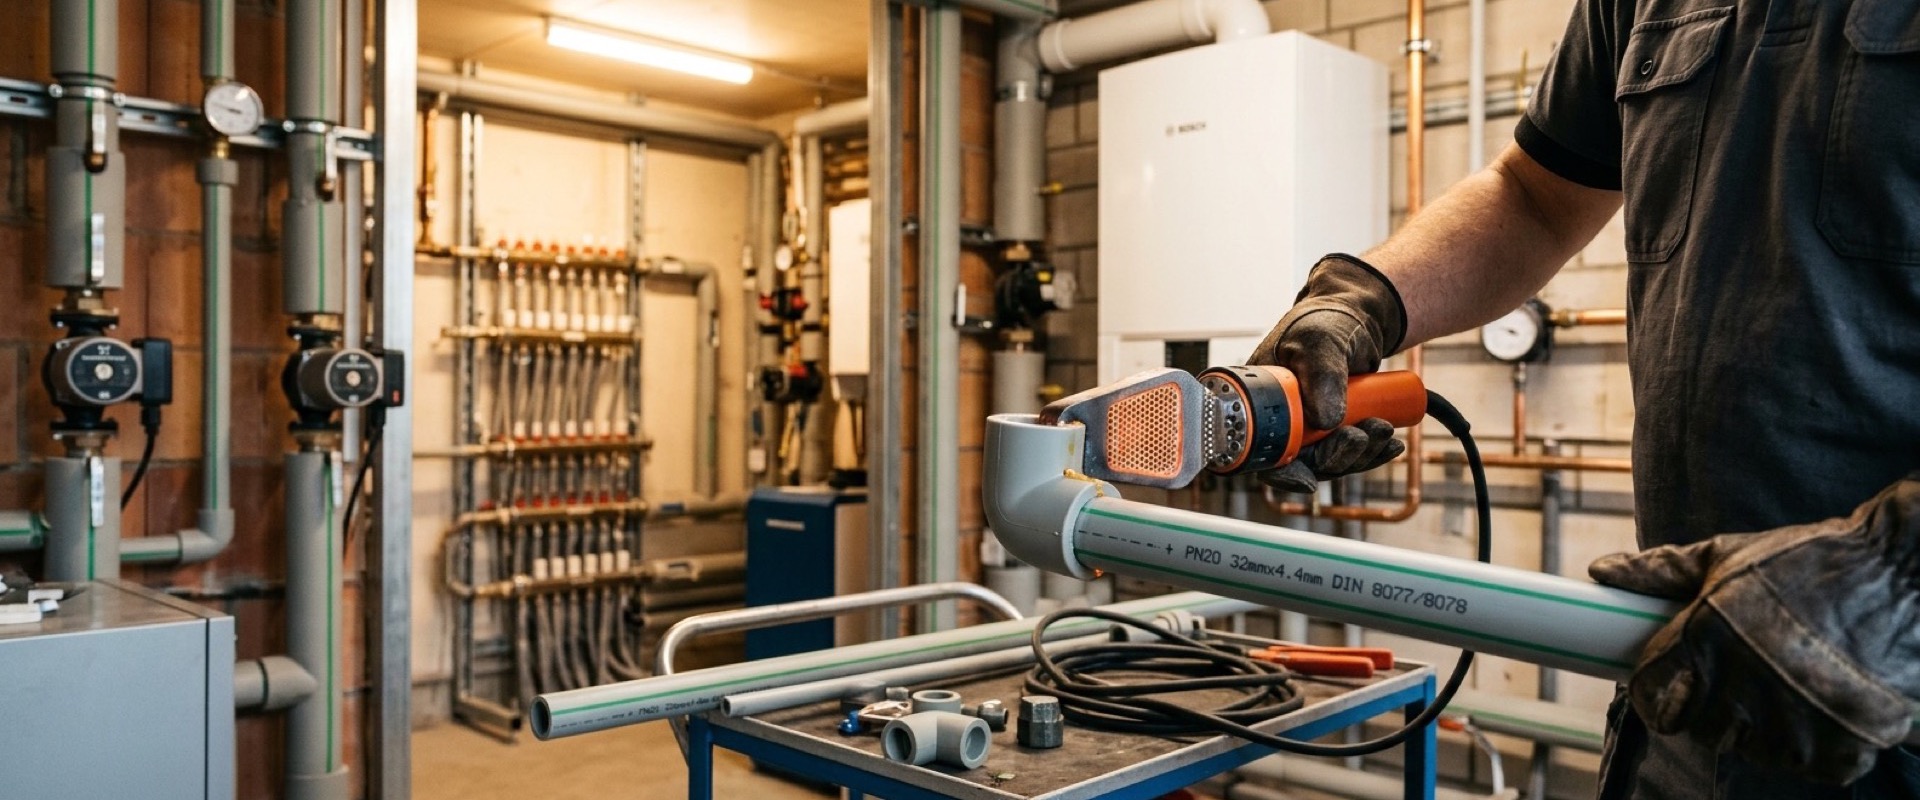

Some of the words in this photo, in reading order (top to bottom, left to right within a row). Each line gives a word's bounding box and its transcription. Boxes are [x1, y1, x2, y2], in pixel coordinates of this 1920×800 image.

[1185, 545, 1222, 565] PN20
[1332, 574, 1364, 594] DIN
[1372, 582, 1468, 614] 8077/8078
